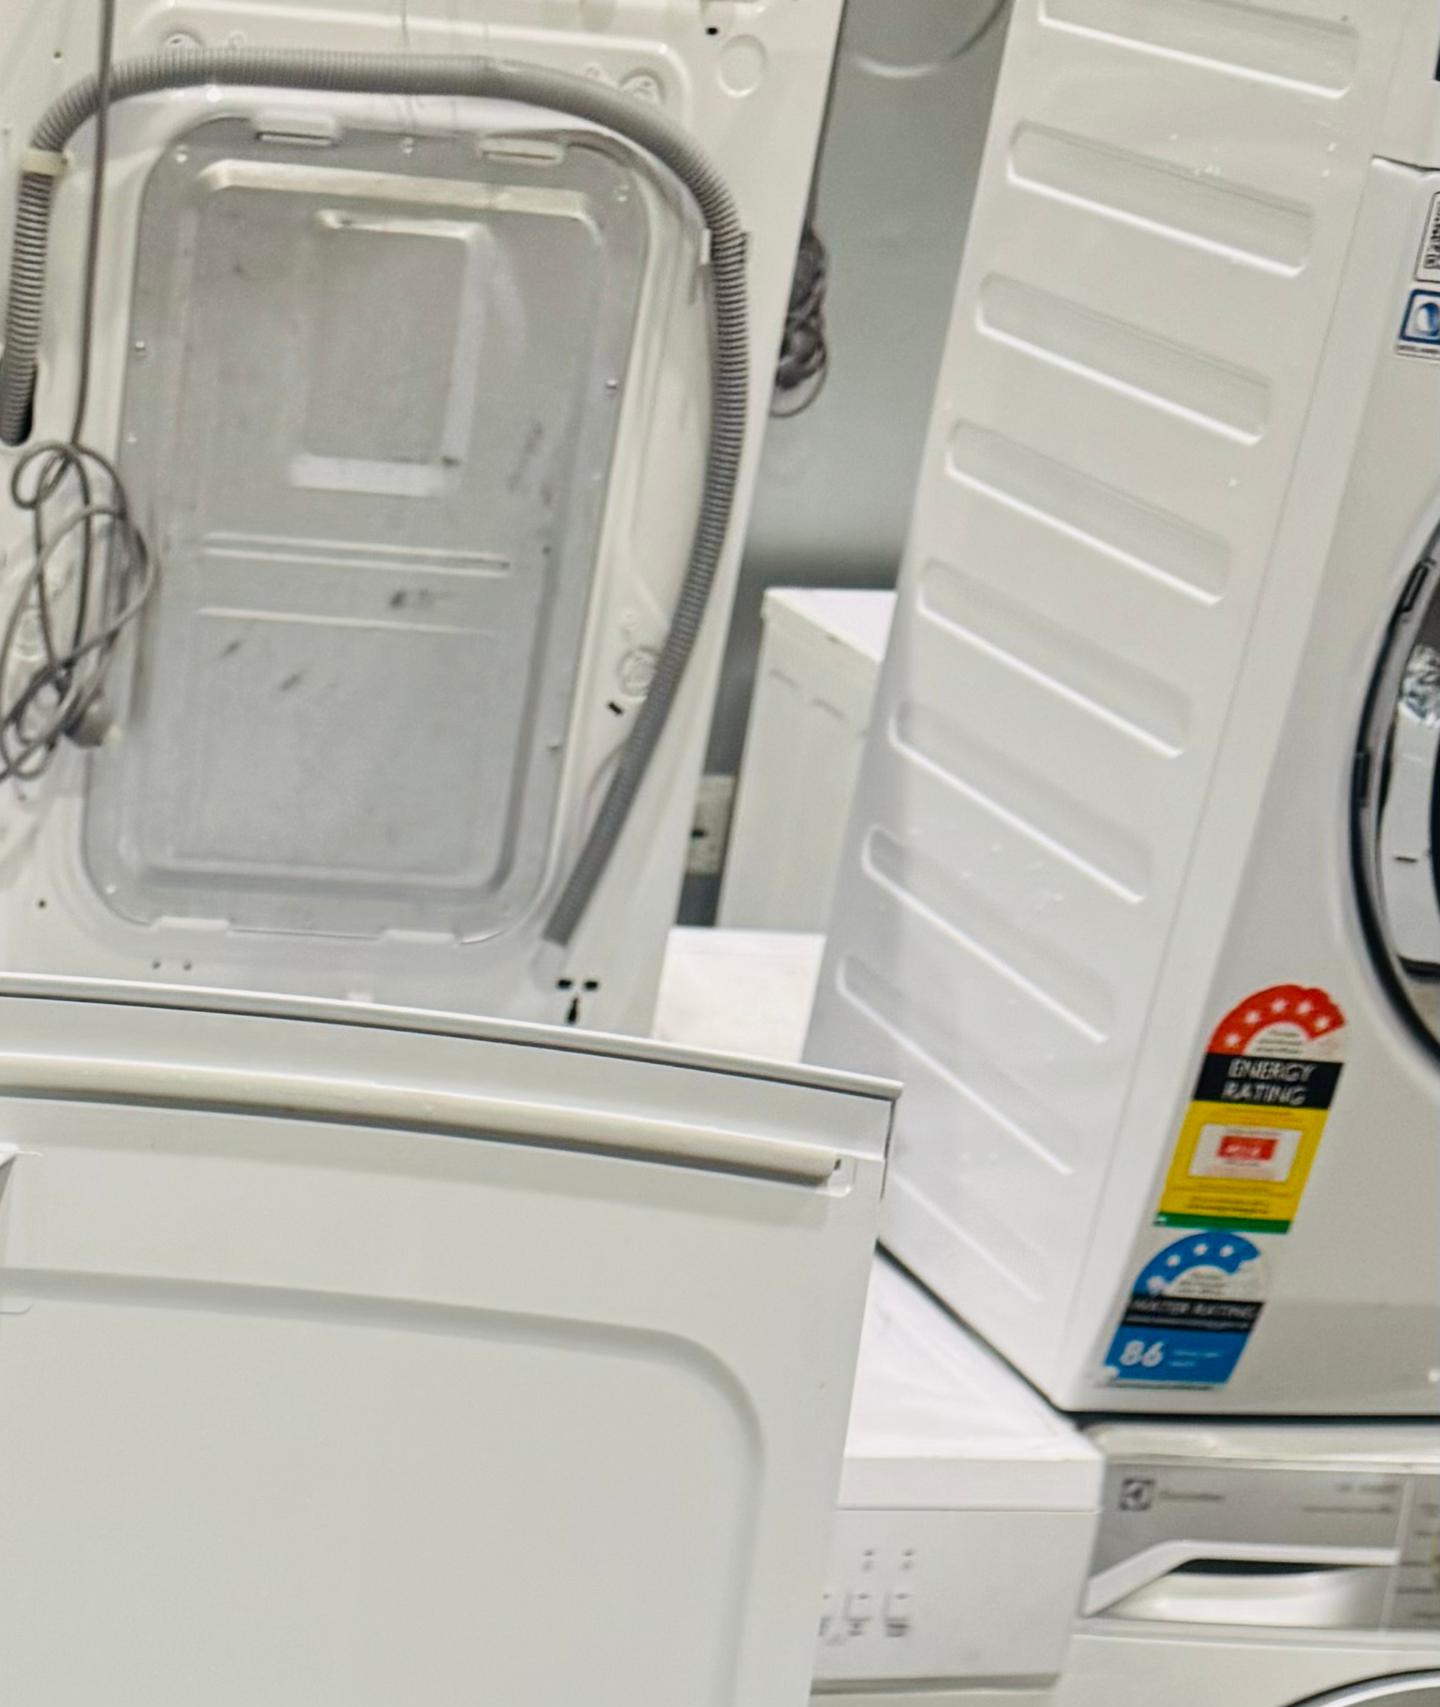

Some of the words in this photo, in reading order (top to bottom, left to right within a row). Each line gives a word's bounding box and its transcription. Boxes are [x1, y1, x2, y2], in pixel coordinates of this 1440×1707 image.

[1227, 1058, 1317, 1083] ENERGY
[1221, 1080, 1309, 1106] RATING
[1119, 1339, 1165, 1368] 86
